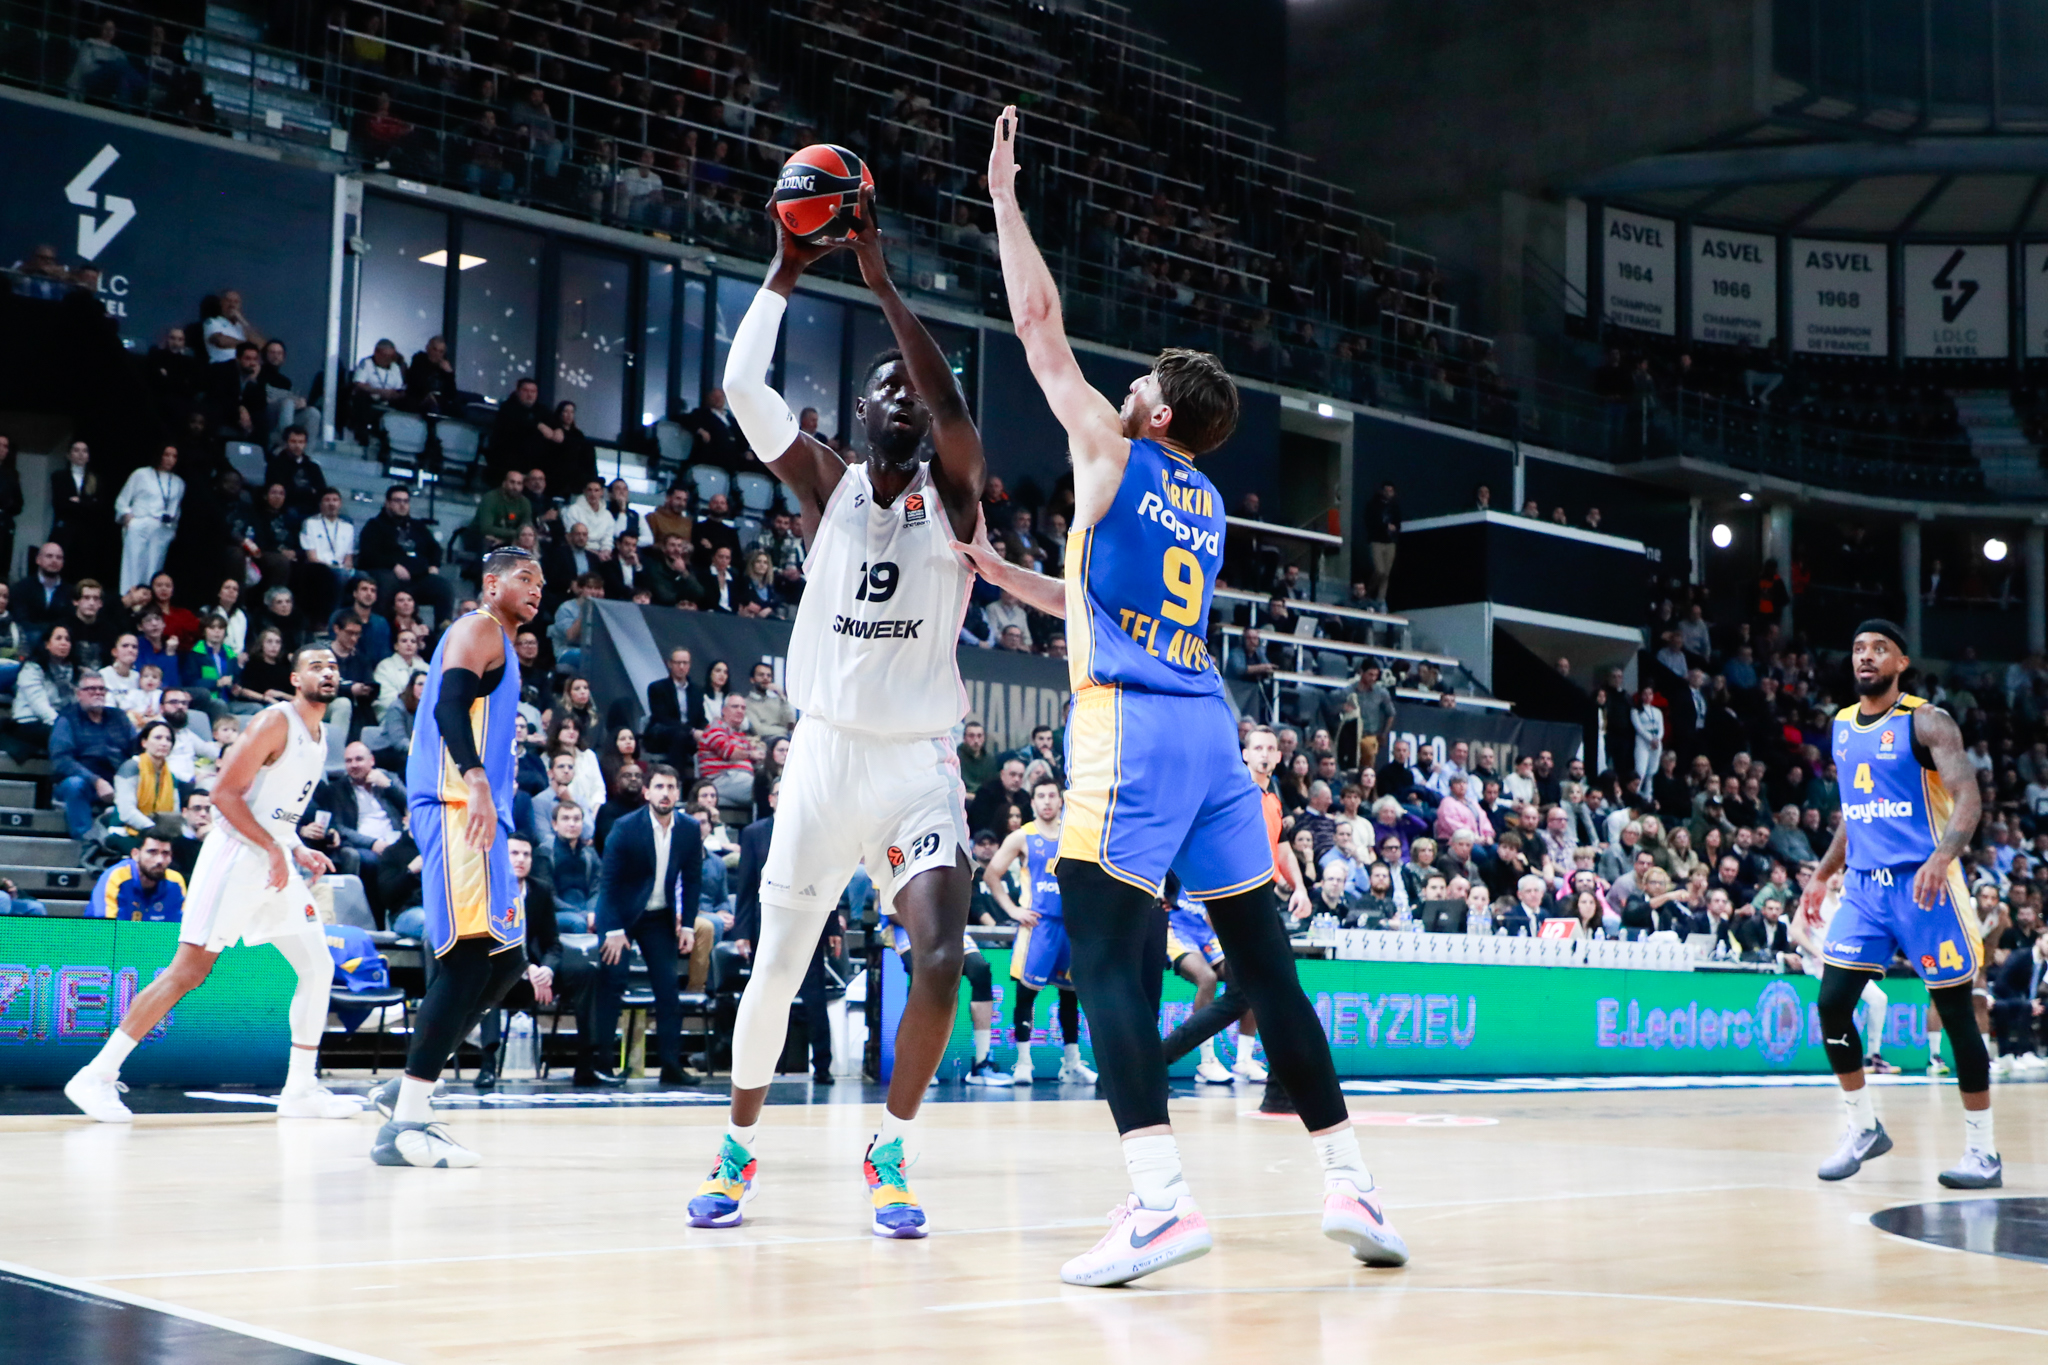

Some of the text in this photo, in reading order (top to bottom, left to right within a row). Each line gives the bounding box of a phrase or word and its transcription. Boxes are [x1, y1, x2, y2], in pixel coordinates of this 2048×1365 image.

[1610, 221, 1663, 248] ASVEL
[1702, 239, 1763, 264] ASVEL
[1806, 251, 1873, 272] ASVEL
[1618, 261, 1654, 284] 1964
[1712, 279, 1751, 300] 1966
[1817, 290, 1860, 310] 1968
[1610, 296, 1662, 315] CHAMPION
[1624, 312, 1661, 330] FRANCE
[1703, 313, 1762, 330] CHAMPION
[1807, 323, 1872, 337] CHAMPION
[1703, 327, 1717, 338] DE
[1933, 328, 1978, 344] LDLC
[1808, 339, 1870, 352] DE FRANCE
[1934, 345, 1978, 356] ASVEL
[1137, 491, 1220, 556] Rapyd
[855, 561, 900, 603] 19
[1162, 545, 1204, 627] 9
[833, 614, 924, 639] SKWEEK
[1120, 607, 1160, 657] TEL
[1854, 763, 1875, 794] 4
[297, 780, 312, 802] 9
[11, 814, 22, 826] D
[57, 875, 69, 886] C
[1939, 940, 1964, 971] 4
